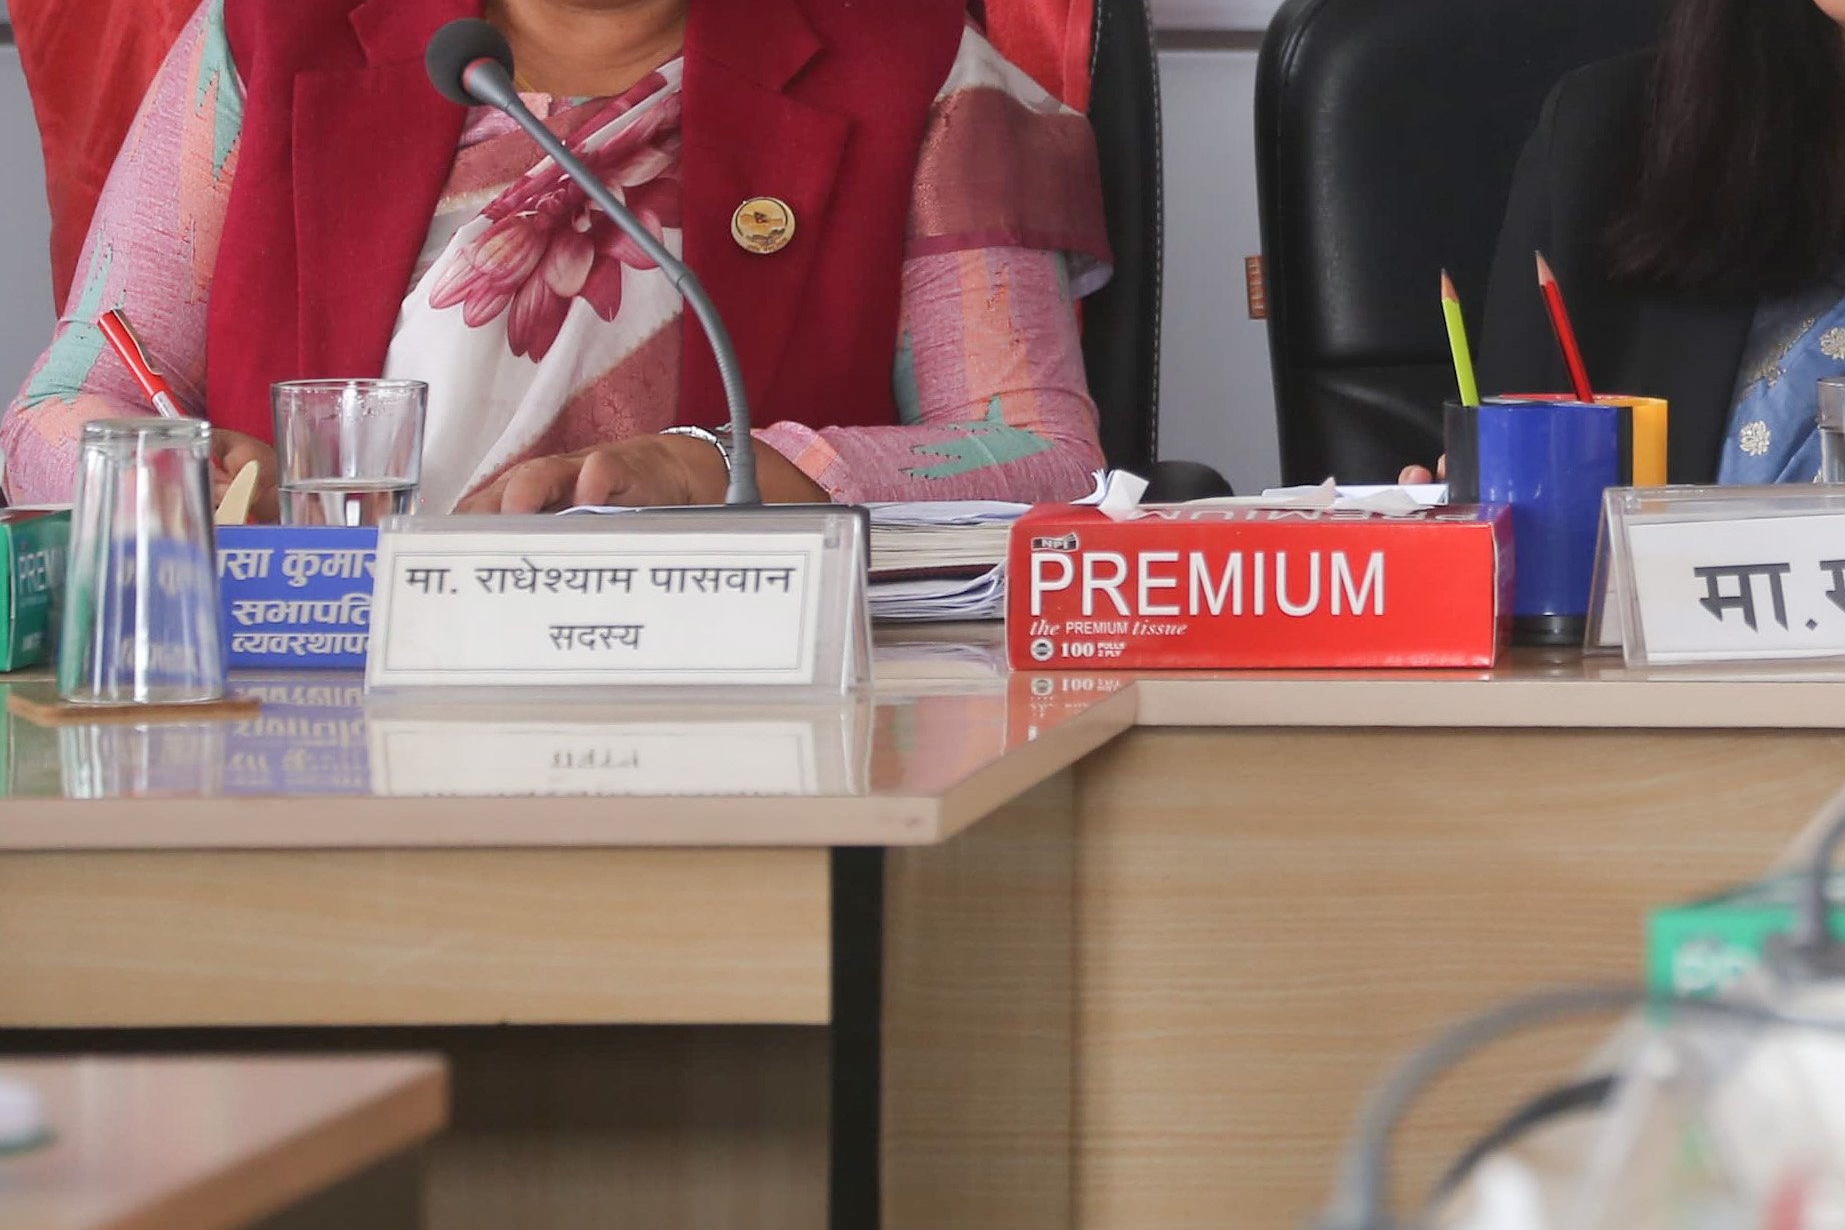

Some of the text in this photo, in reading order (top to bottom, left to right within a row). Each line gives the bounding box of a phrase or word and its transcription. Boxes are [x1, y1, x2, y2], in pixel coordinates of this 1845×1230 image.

[405, 557, 796, 595] मा. राधेश्याम पासवान
[1030, 552, 1384, 616] PREMIUM
[549, 624, 645, 651] सदस्य
[1029, 619, 1188, 636] the PREMIUM tissue
[231, 633, 370, 656] व्यवस्थाप
[1061, 642, 1094, 657] 100
